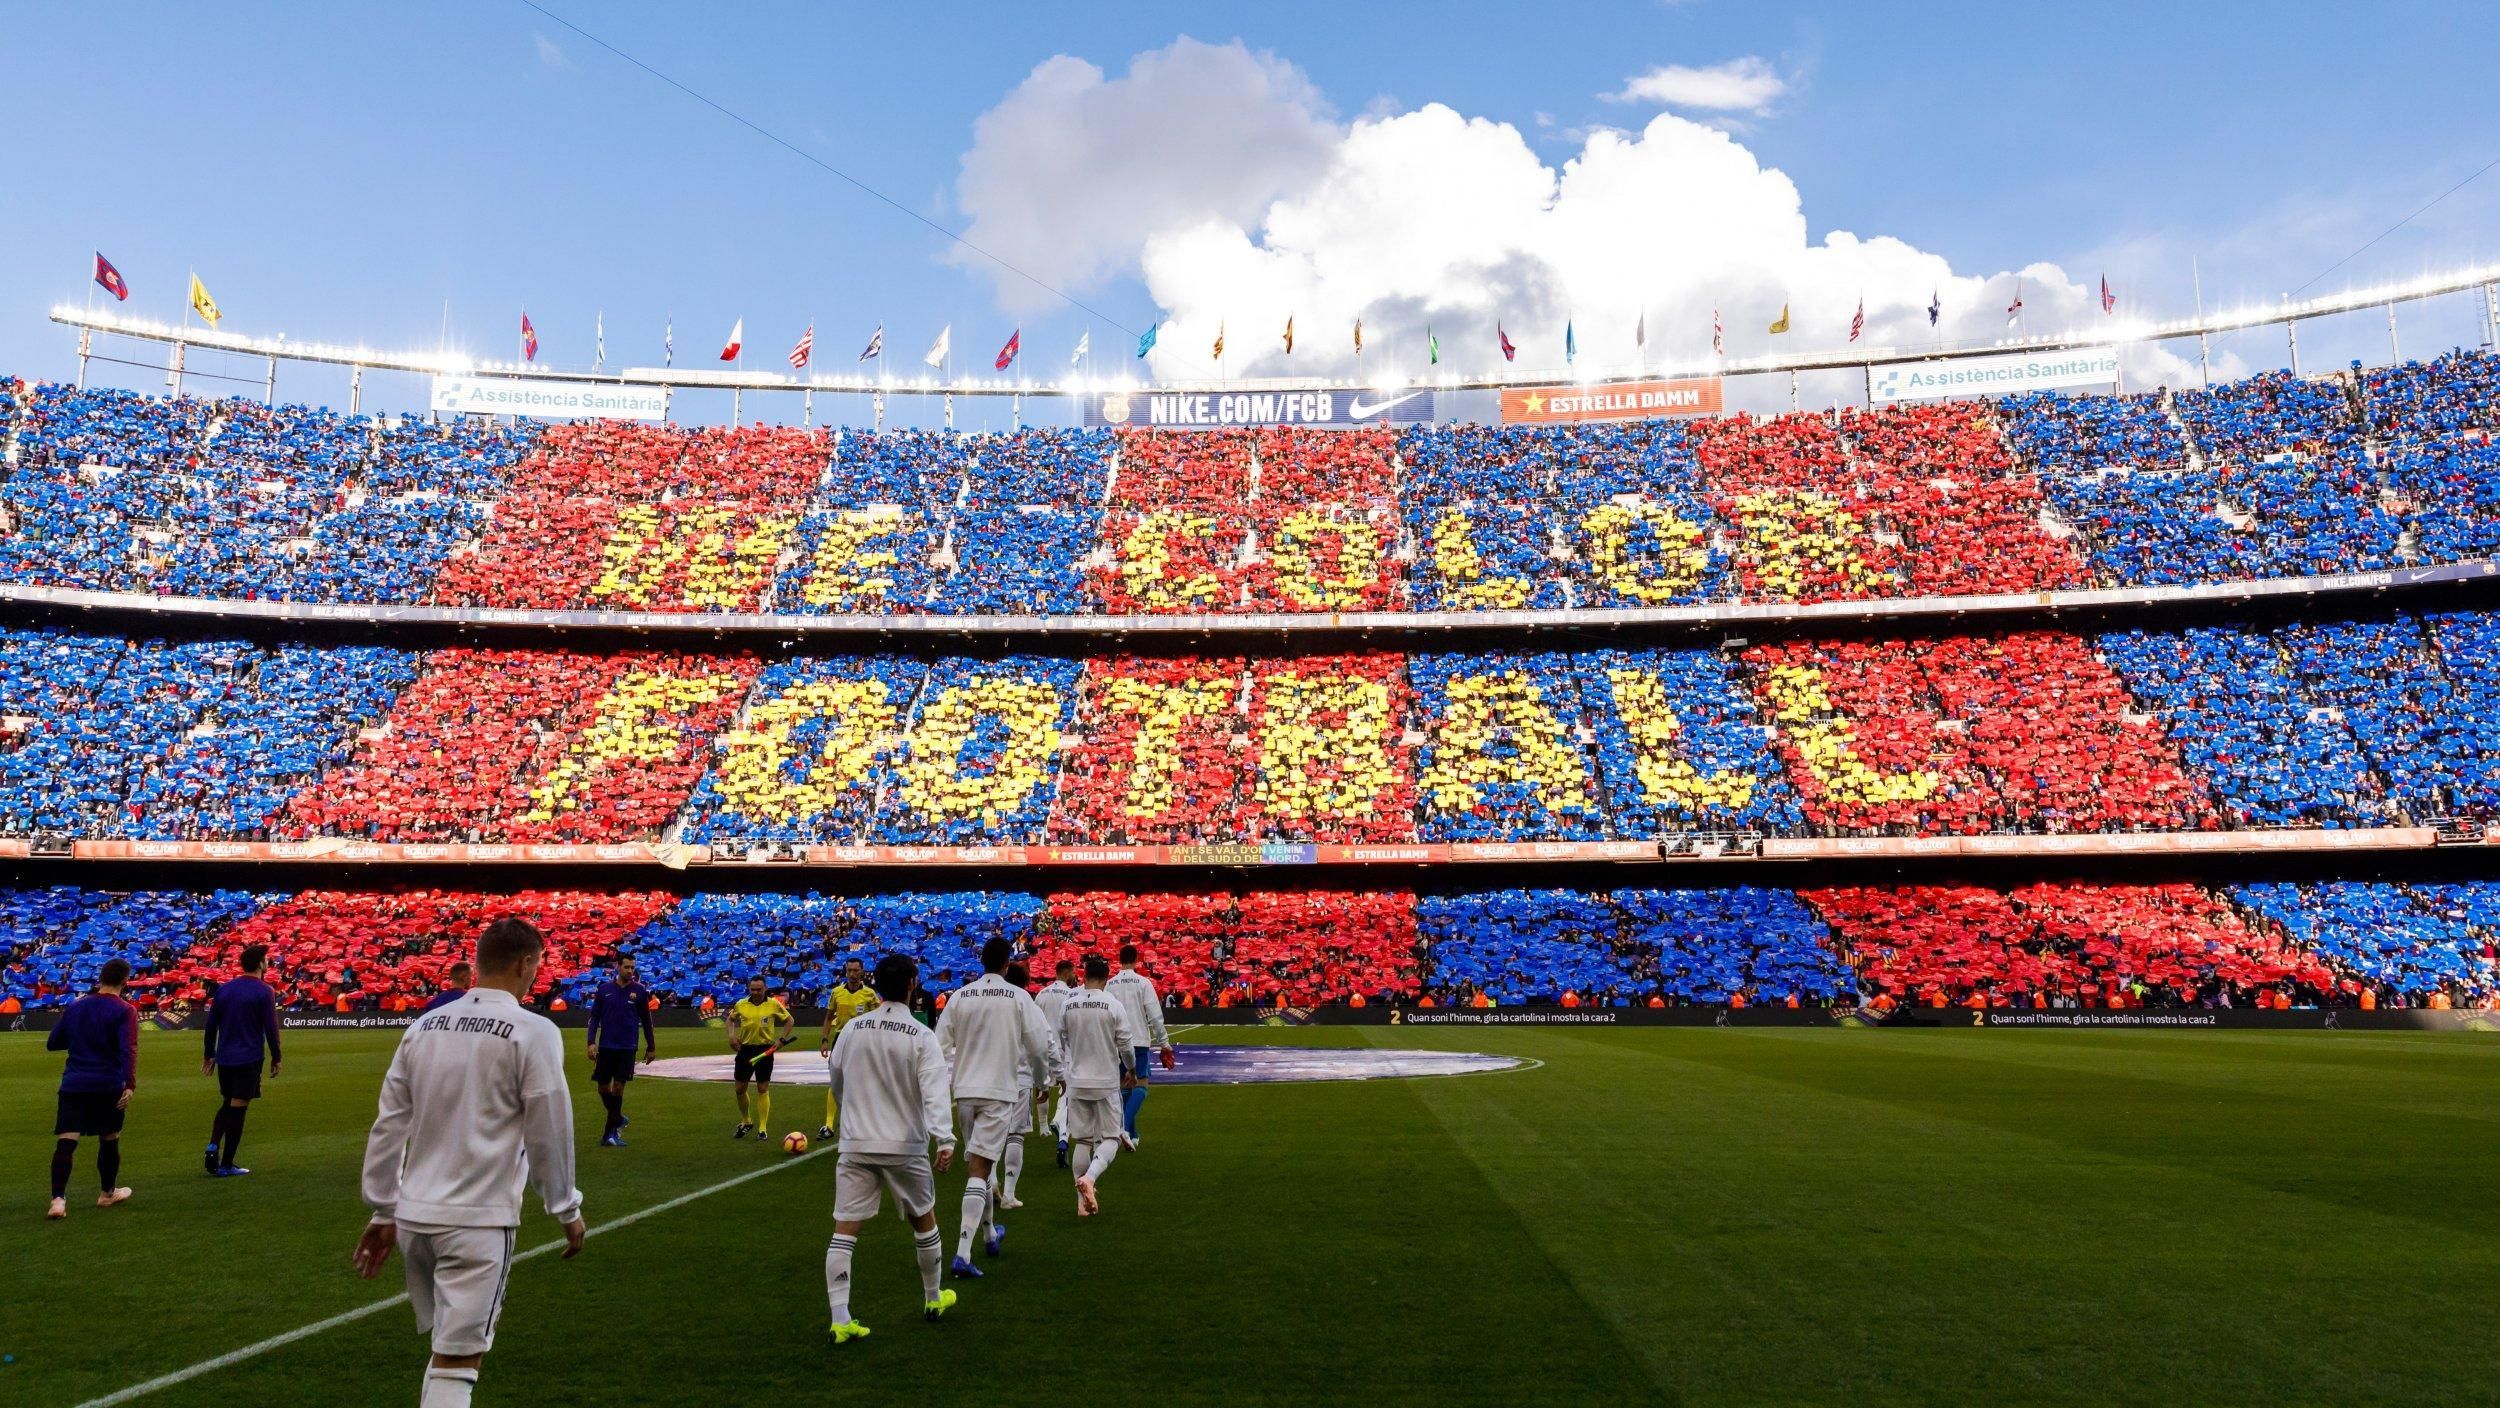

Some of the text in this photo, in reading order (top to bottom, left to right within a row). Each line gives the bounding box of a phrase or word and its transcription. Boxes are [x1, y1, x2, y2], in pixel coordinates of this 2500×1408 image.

[1910, 357, 2117, 387] Assistència Sanitària
[470, 387, 662, 411] Assistència Sanitària
[1550, 390, 1700, 413] ESTRELLA DAMM
[1150, 393, 1333, 424] NIKE.COM/FCB
[2322, 573, 2392, 589] NIKE.COM/FCB
[312, 607, 371, 617] NIKE.COM/FCB
[627, 615, 682, 625] NIKE.COM/FCB
[778, 617, 832, 627] NIKE.COM/FCB
[926, 618, 979, 628] NIKE.COM/FCB
[1073, 618, 1125, 628] NIKE.COM/FCB
[1218, 617, 1270, 628] NIKE.COM/FCB
[1364, 615, 1417, 626] NIKE.COM/FCB
[526, 663, 1940, 824] FOOTBALL
[1972, 837, 2019, 848] Rakuten
[2039, 836, 2087, 847] Rakuten
[2108, 835, 2156, 846] Rakuten
[2179, 833, 2228, 845] Rakuten
[2250, 833, 2300, 844] Rakuten
[2323, 831, 2375, 843] Rakuten
[135, 843, 182, 854] Rakuten
[204, 844, 250, 854] Rakuten
[1535, 844, 1579, 854] Rakuten
[1597, 843, 1641, 854] Rakuten
[1773, 839, 1819, 851] Rakuten
[1839, 839, 1884, 850] Rakuten
[1904, 838, 1950, 849] Rakuten
[271, 844, 307, 855] Rakut
[403, 846, 448, 856] Rakuten
[467, 847, 512, 857] Rakuten
[532, 847, 576, 857] Rakuten
[596, 847, 639, 857] Rakuten
[836, 848, 878, 859] Rakuten
[896, 848, 938, 859] Rakuten
[957, 848, 999, 858] Rakuten
[1167, 846, 1306, 855] TANT SE VAL D'ON VENIM,
[1355, 850, 1398, 859] ESTRELLA
[1474, 845, 1517, 856] Rakuten
[1062, 852, 1105, 860] ESTRELLA
[1170, 855, 1303, 863] SI DEL SUD O DEL NORD.
[960, 988, 1015, 998] REAL MADRID
[1066, 1002, 1109, 1011] REAL MADRID
[283, 1016, 416, 1027] Quan soni l'himne, gira la cartolin
[1390, 1010, 1401, 1024] 2
[1407, 1013, 1430, 1024] Quan
[1431, 1013, 1448, 1022] soni
[1449, 1013, 1482, 1023] l'himne,
[1483, 1013, 1500, 1024] gira
[1501, 1013, 1509, 1022] la
[1510, 1013, 1546, 1022] cartolina
[1551, 1013, 1581, 1022] mostra
[1582, 1013, 1590, 1022] la
[1610, 1013, 1616, 1022] 2
[1972, 1011, 1984, 1026] 2
[1991, 1014, 2015, 1024] Quan
[2016, 1014, 2035, 1023] soni
[2036, 1014, 2072, 1025] l'himne,
[2073, 1014, 2090, 1025] gira
[2091, 1014, 2100, 1023] la
[2101, 1014, 2140, 1024] cartolina
[2146, 1015, 2178, 1024] mostra
[2178, 1014, 2187, 1024] la
[2188, 1016, 2208, 1024] cara
[2209, 1015, 2216, 1024] 2
[420, 1016, 515, 1039] REAL MADRID
[853, 1019, 918, 1036] REAL MADRID
